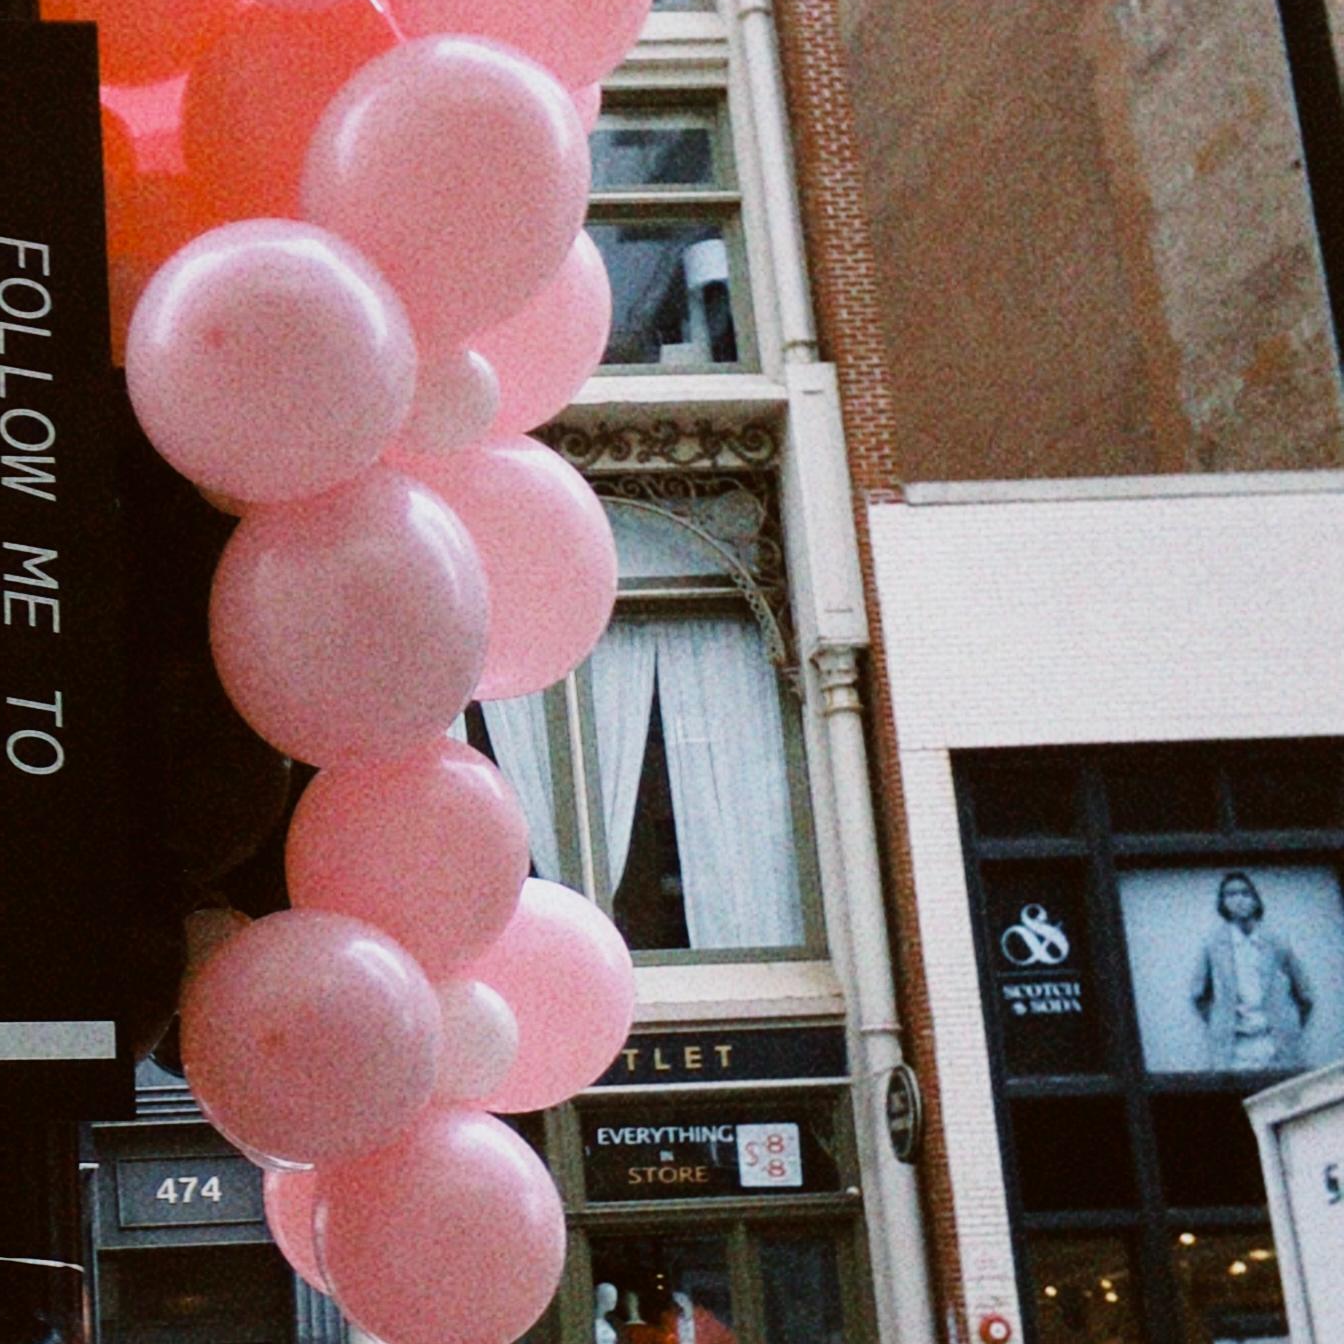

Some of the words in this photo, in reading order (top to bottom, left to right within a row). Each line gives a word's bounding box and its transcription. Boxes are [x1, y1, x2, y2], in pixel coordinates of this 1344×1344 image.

[2, 541, 60, 633] ME
[6, 690, 65, 775] TO
[597, 1125, 734, 1146] EVERYTHING
[155, 1175, 223, 1205] 474
[628, 1165, 710, 1185] STORE
